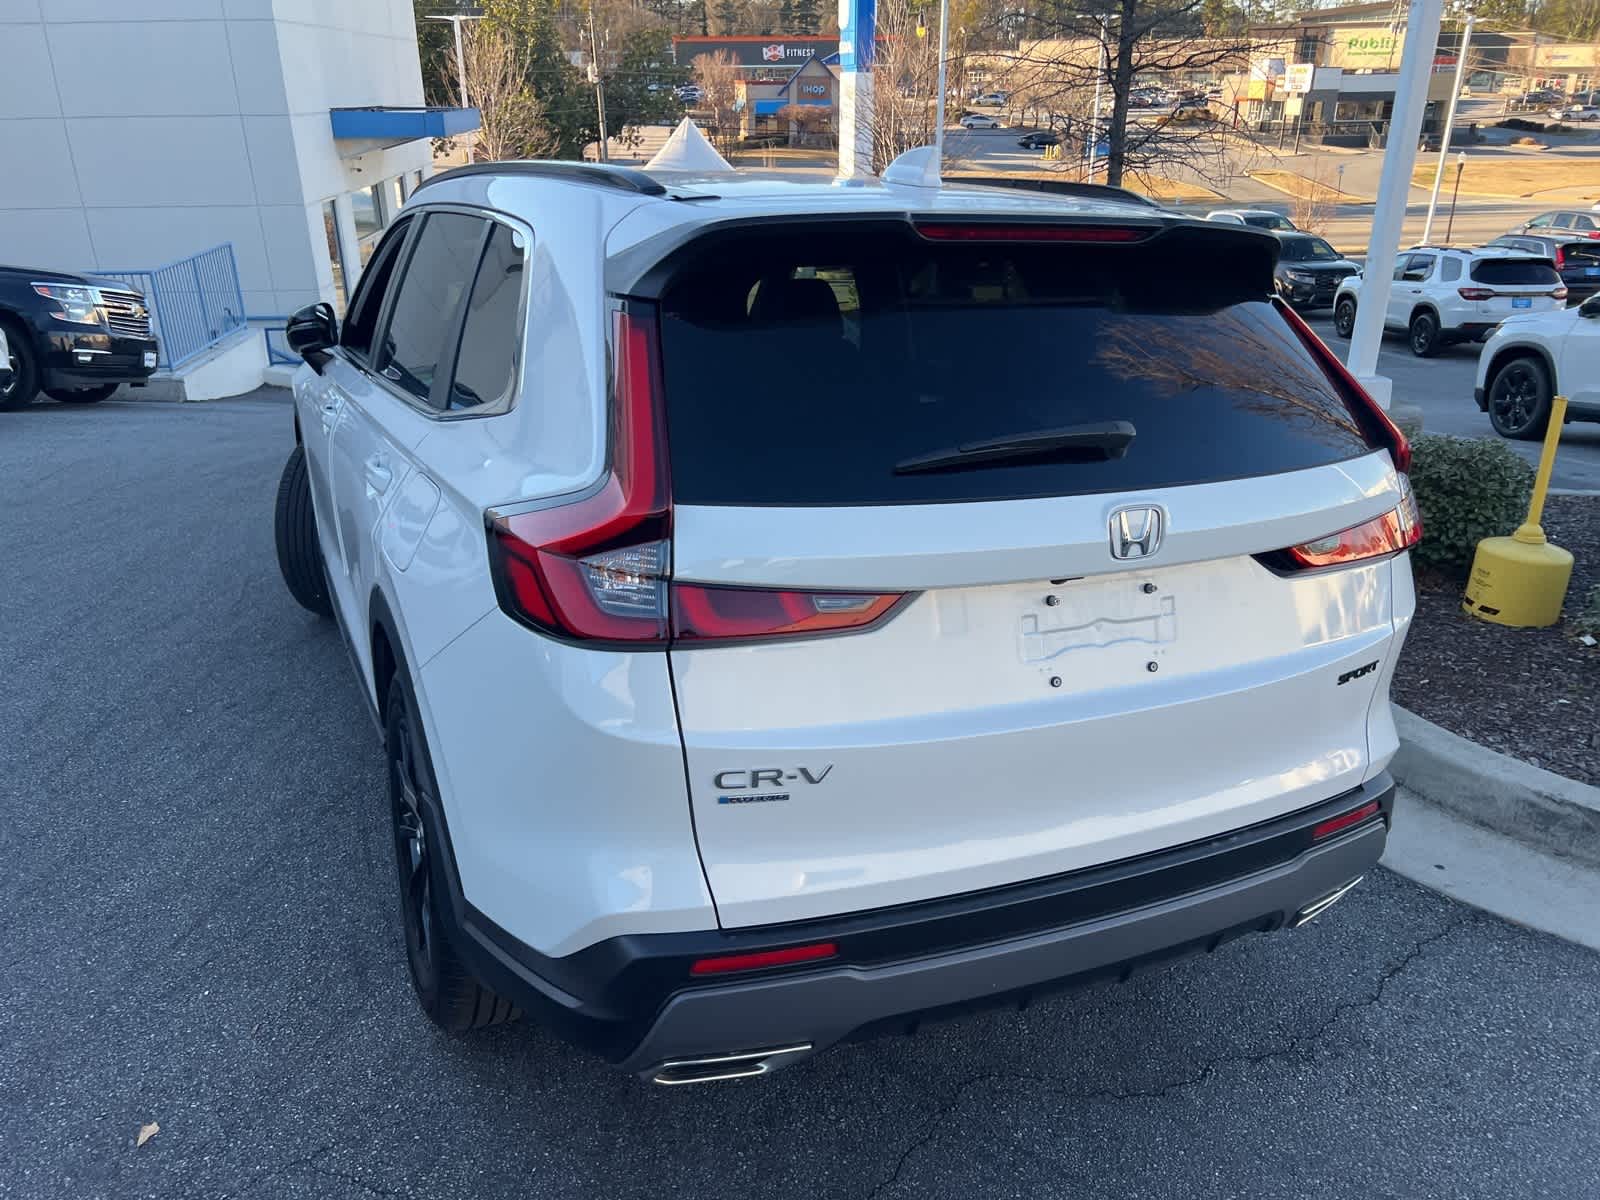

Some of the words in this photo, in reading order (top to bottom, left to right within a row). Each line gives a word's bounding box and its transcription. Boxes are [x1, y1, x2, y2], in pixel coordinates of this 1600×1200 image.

[786, 48, 815, 57] FITNESS
[1337, 659, 1380, 686] SPORT
[713, 763, 834, 790] CR-V
